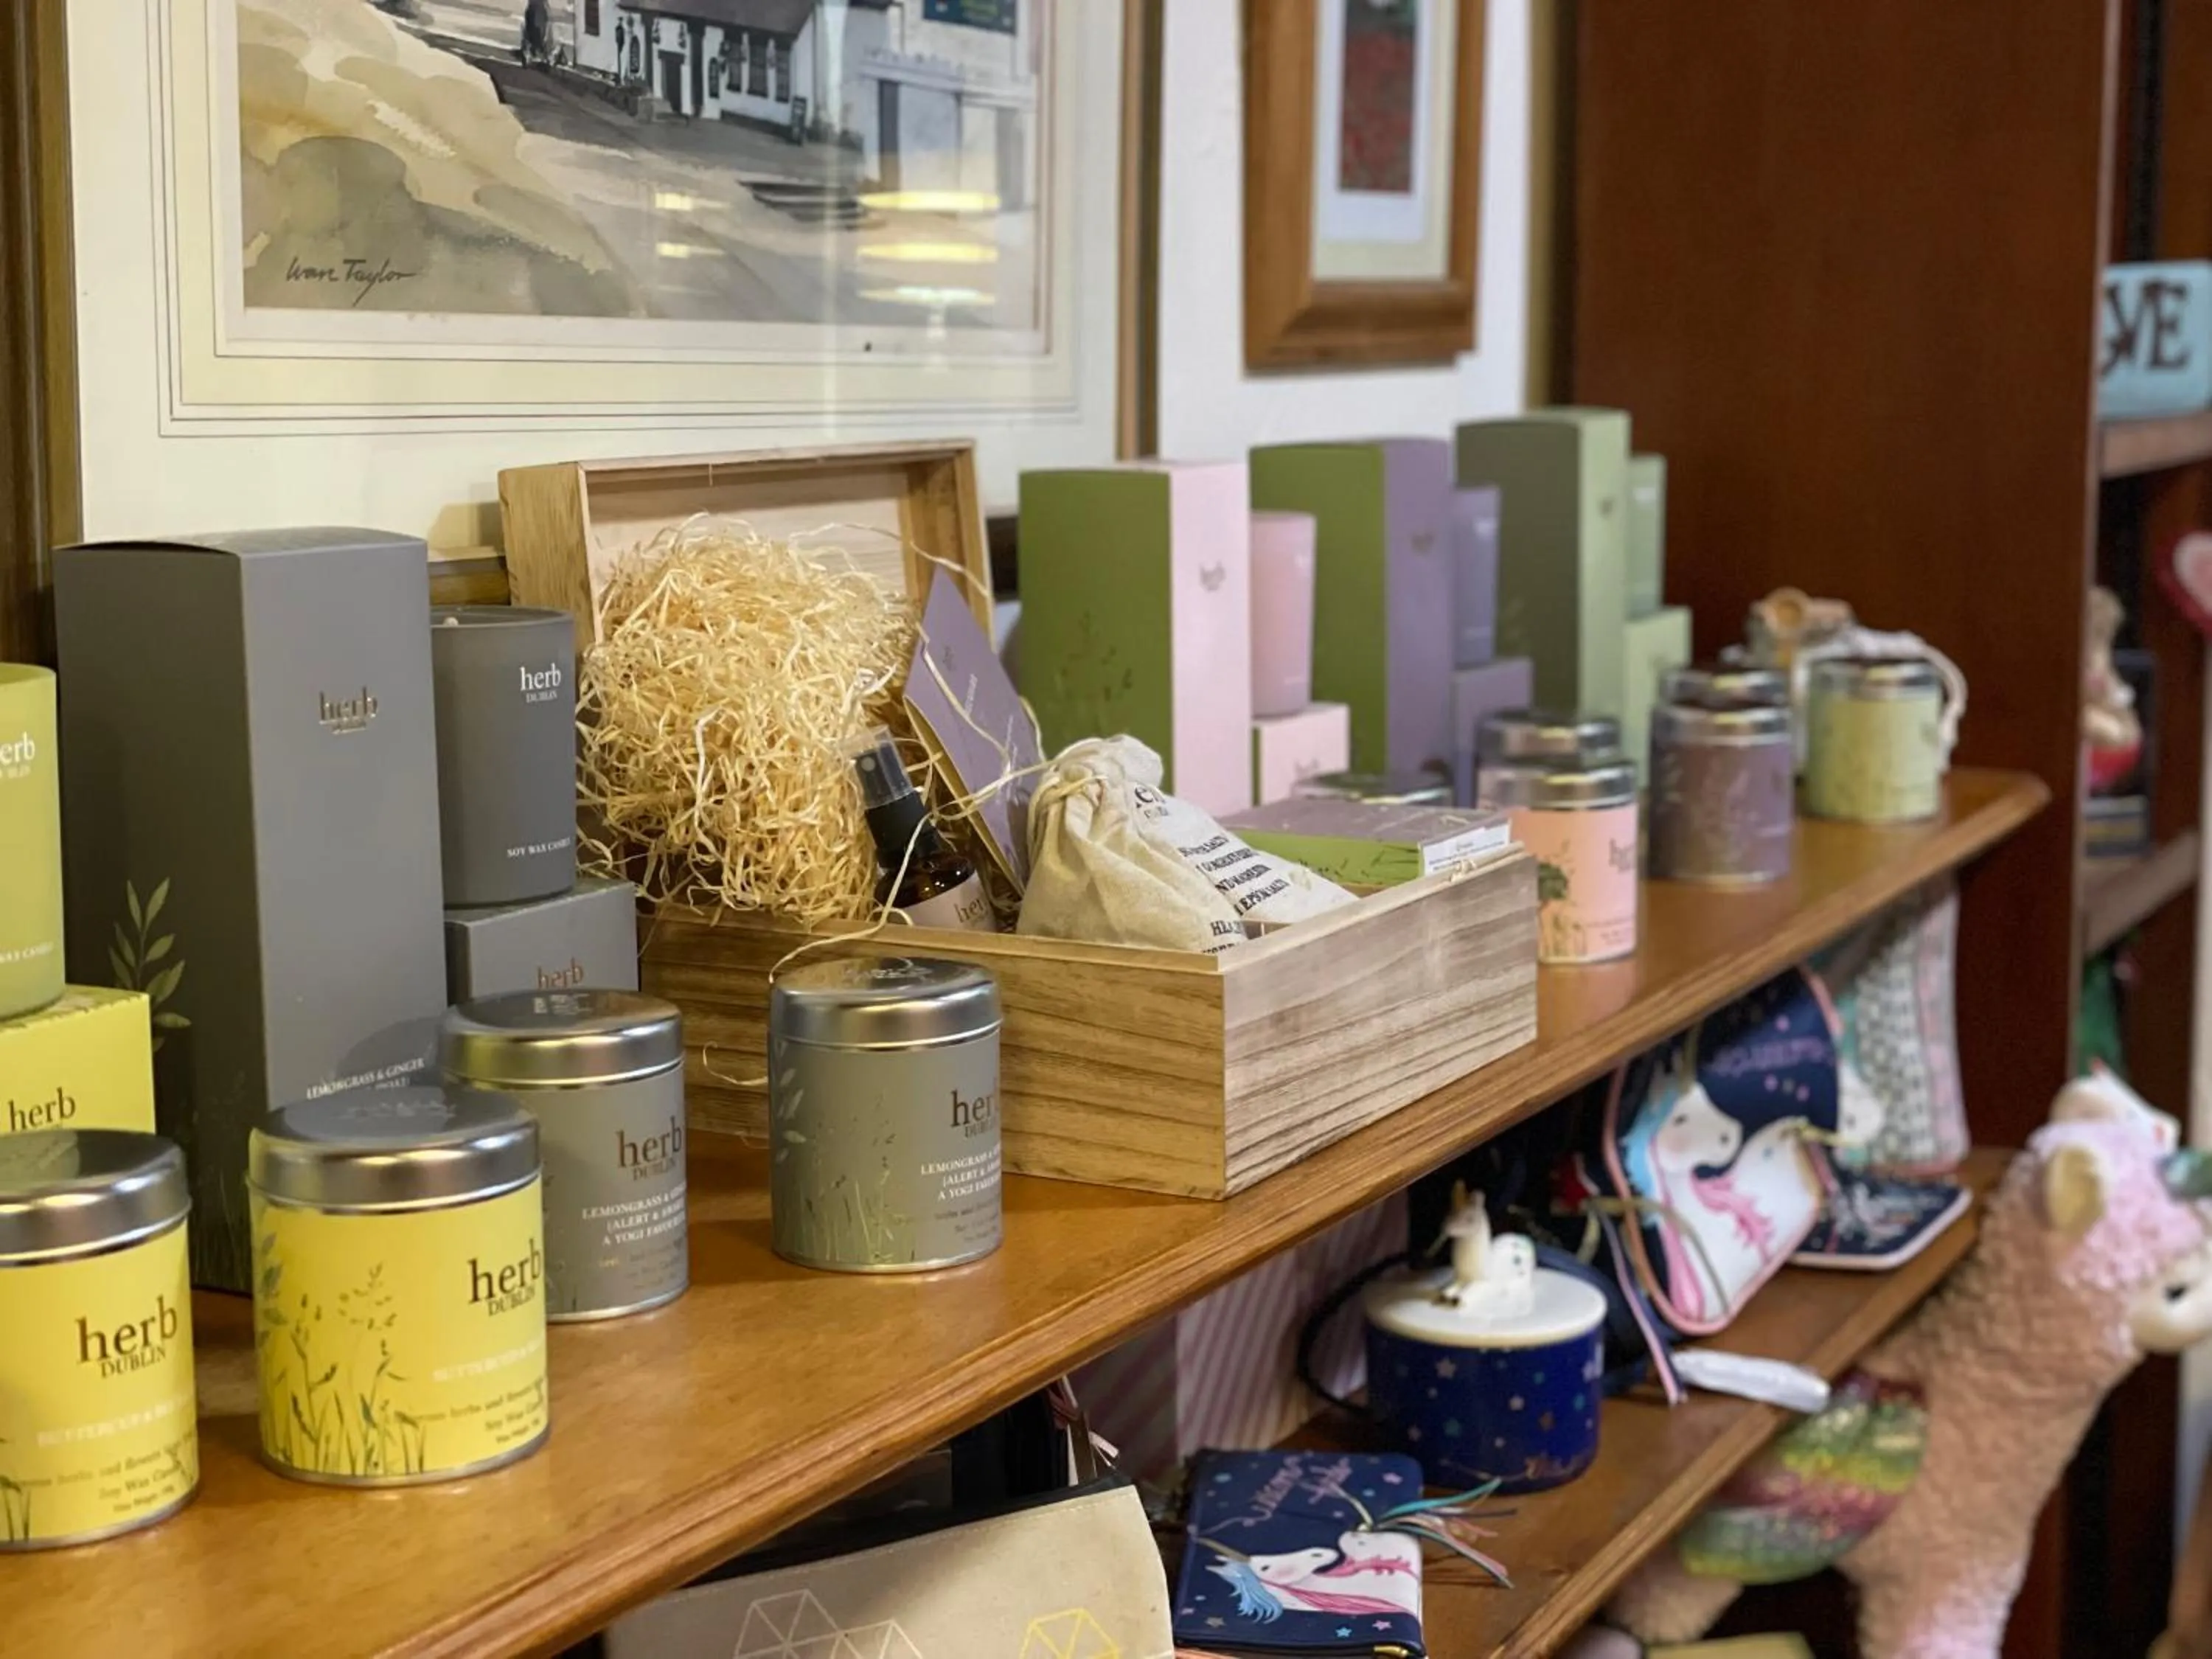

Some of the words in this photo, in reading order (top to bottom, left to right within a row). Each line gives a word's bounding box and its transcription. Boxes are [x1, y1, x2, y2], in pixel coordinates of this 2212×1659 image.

[2101, 280, 2191, 375] VE
[519, 662, 561, 691] herb
[319, 686, 378, 725] herb
[0, 731, 35, 767] erb
[953, 898, 984, 924] her
[537, 956, 584, 990] herb
[306, 1070, 375, 1100] LEMONGRASS
[7, 1085, 76, 1132] herb
[950, 1088, 995, 1128] her
[614, 1114, 682, 1169] herb
[582, 1194, 663, 1220] LEMONGRASS
[467, 1237, 542, 1304] herb
[74, 1293, 178, 1364] herb
[100, 1345, 167, 1379] DUBLIN
